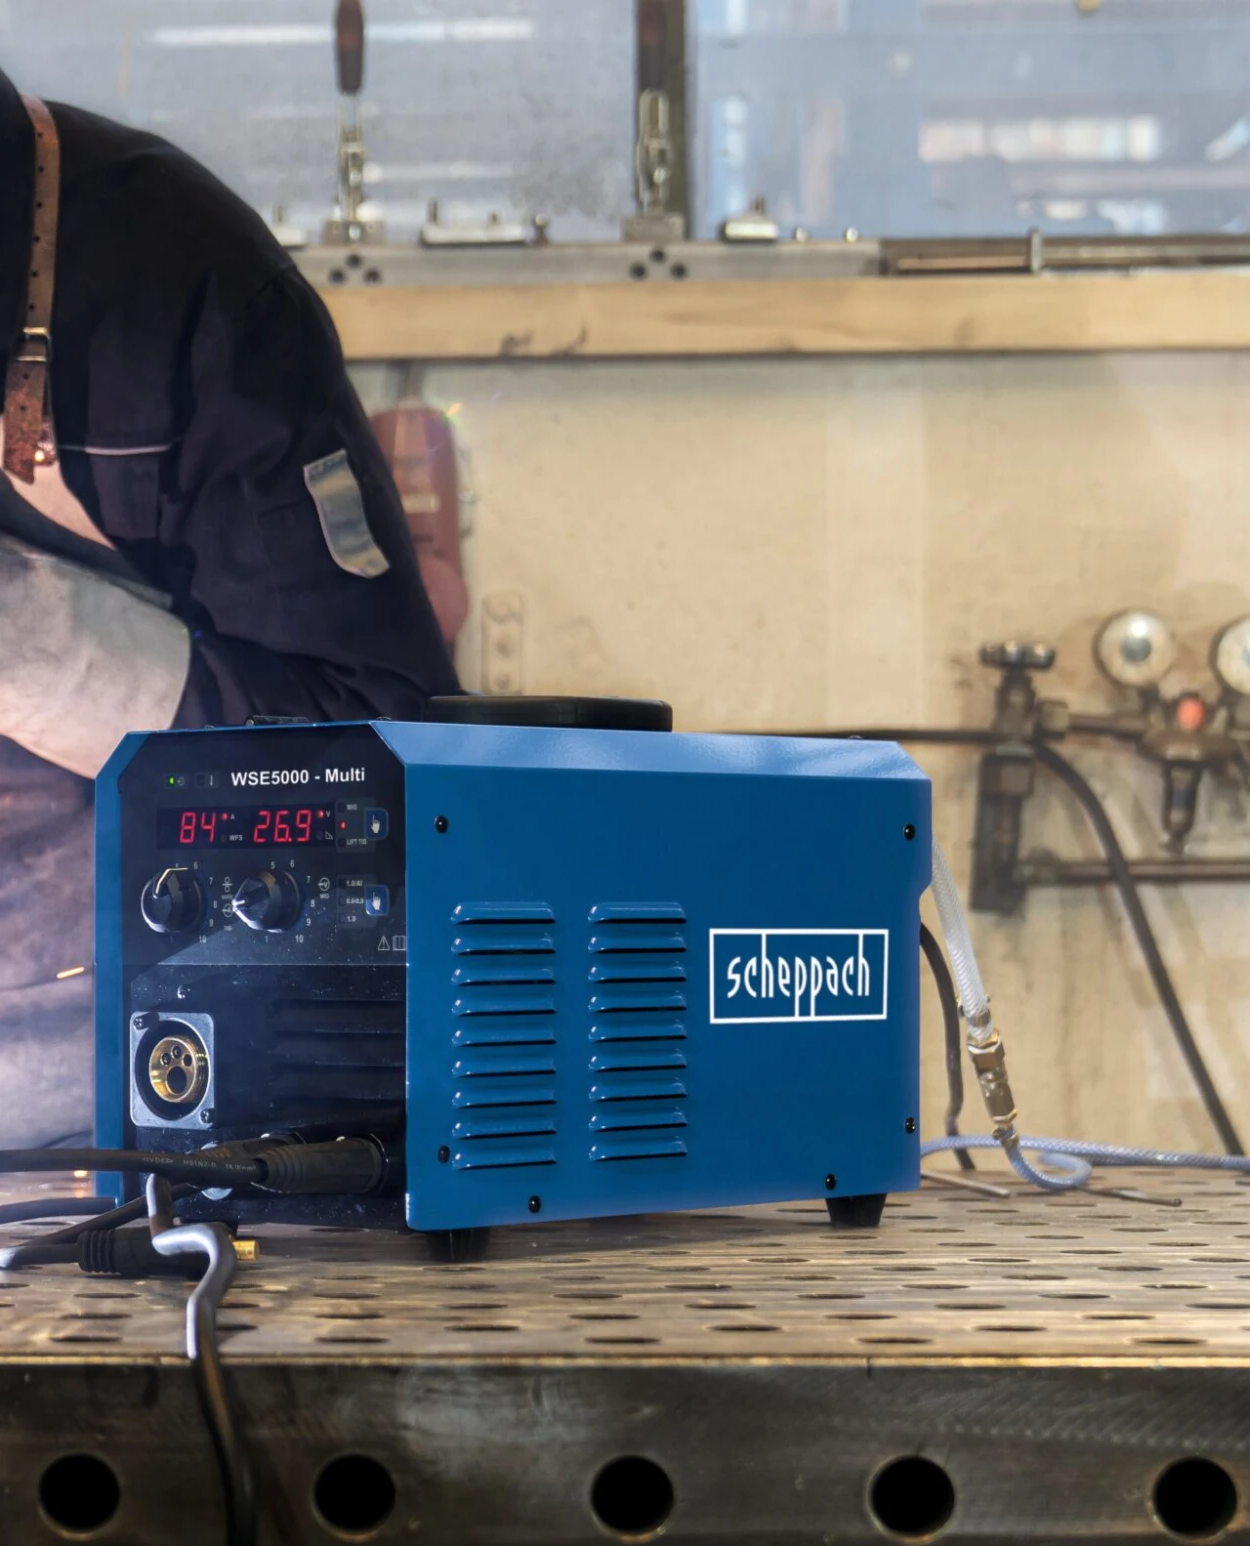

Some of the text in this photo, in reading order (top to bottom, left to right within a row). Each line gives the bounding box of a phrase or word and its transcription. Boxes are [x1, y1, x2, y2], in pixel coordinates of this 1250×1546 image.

[230, 769, 310, 787] WSE5000
[324, 767, 366, 783] Multi
[179, 811, 216, 844] 84
[253, 809, 312, 843] 26.9
[198, 935, 207, 944] 10
[295, 934, 304, 943] 10
[726, 931, 871, 1019] scheppach
